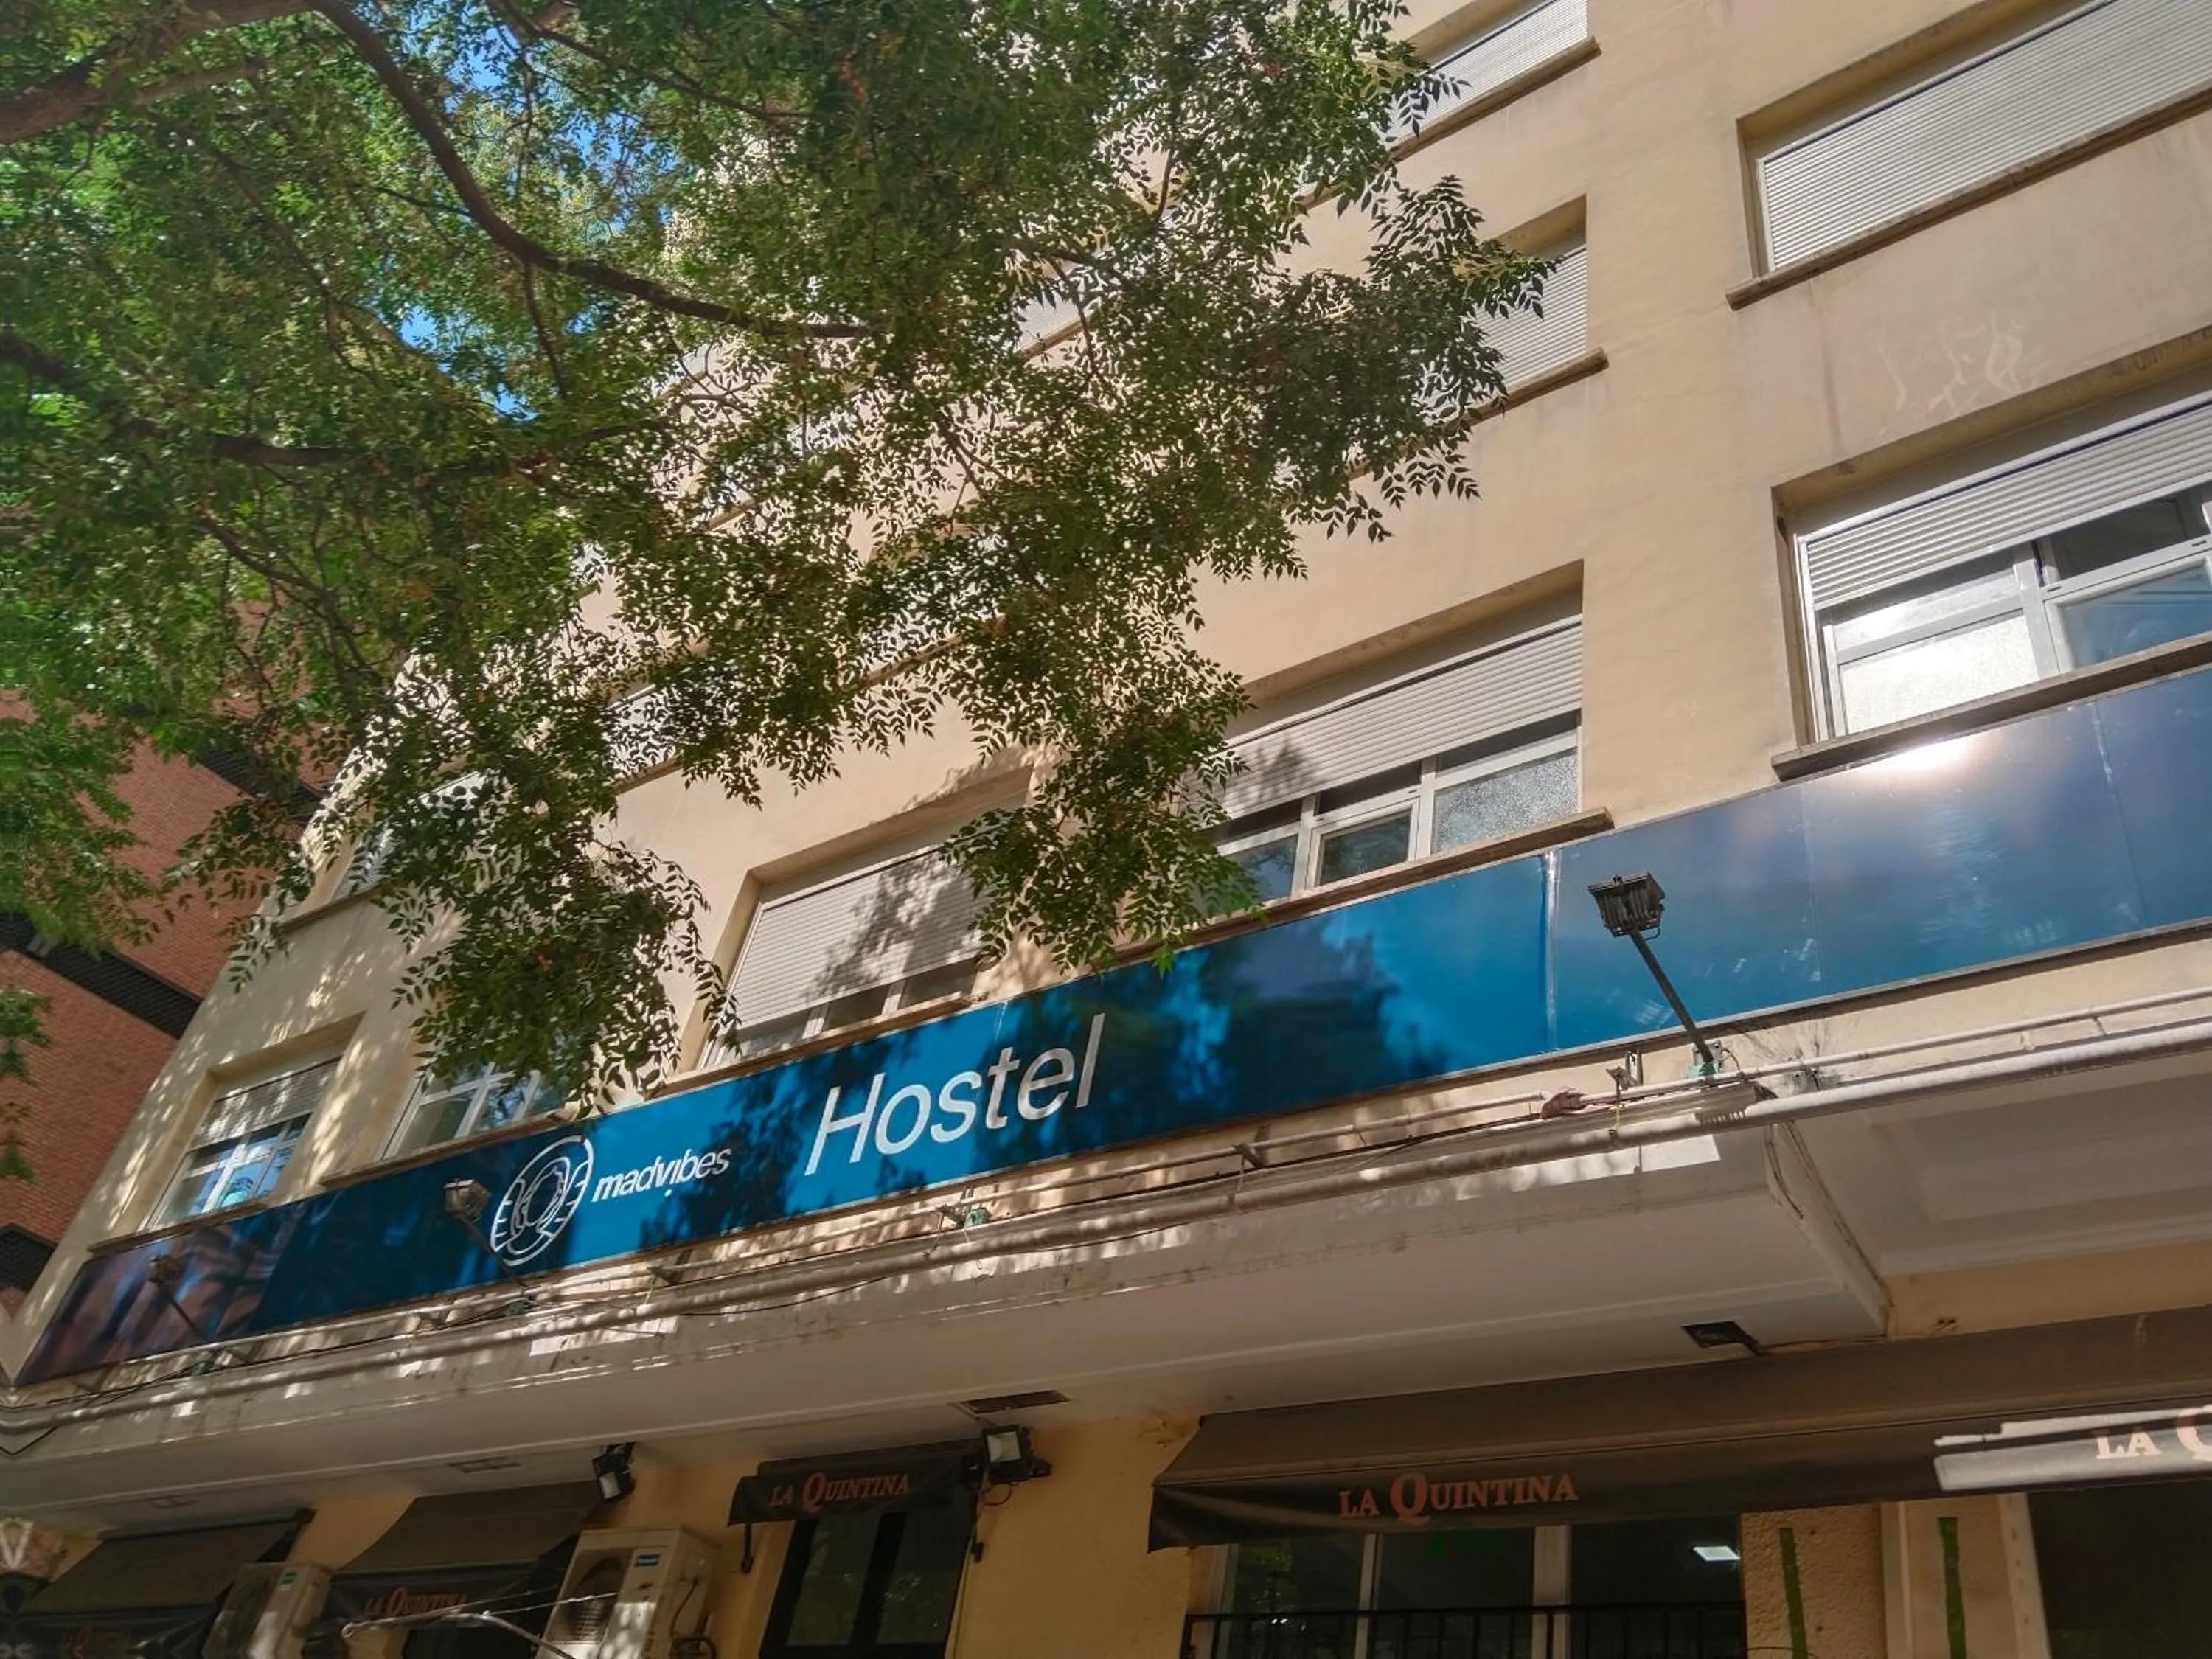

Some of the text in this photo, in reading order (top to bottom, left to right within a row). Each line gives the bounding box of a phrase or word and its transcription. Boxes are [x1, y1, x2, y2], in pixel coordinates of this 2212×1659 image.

[592, 1013, 1105, 1200] madvibes Hostel
[2095, 1427, 2162, 1458] LA
[769, 1472, 907, 1513] LA QUINTINA
[1339, 1472, 1579, 1525] LA QUINTINA
